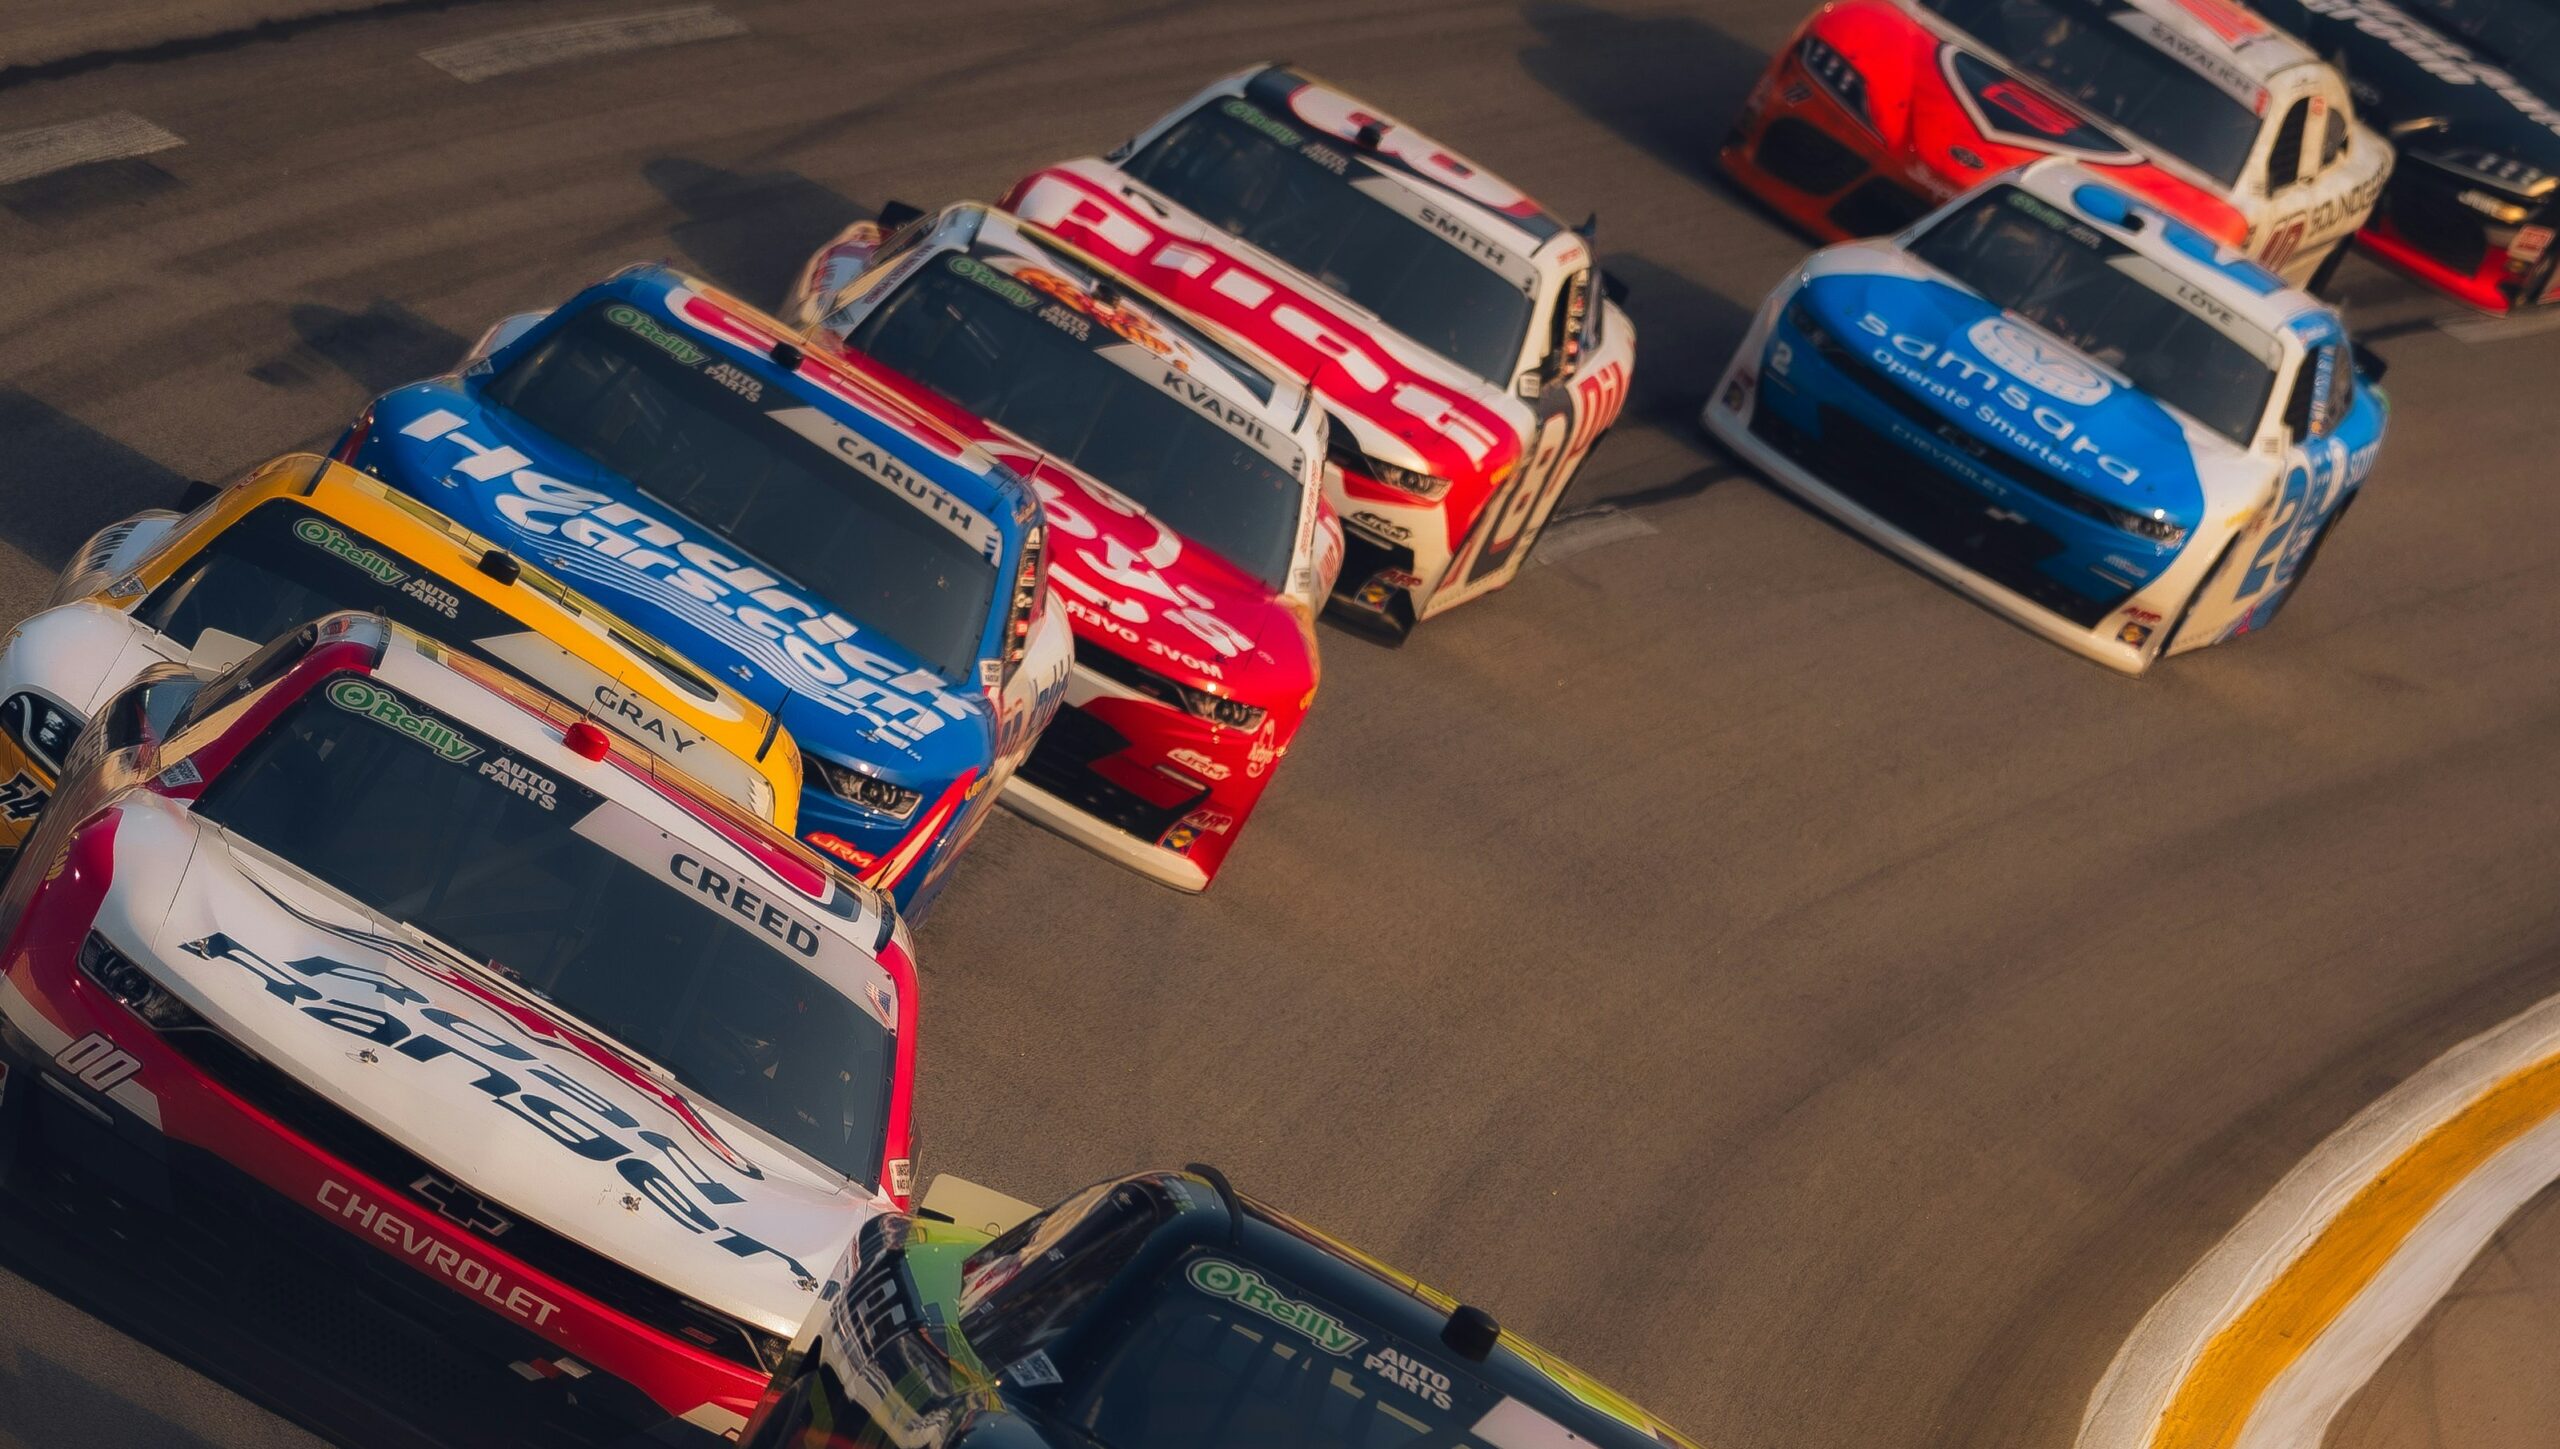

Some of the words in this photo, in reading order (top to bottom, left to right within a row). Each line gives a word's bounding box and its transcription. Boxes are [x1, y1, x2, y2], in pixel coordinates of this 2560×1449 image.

[1418, 206, 1506, 267] SMITH
[1037, 308, 1090, 342] PARTS
[1049, 305, 1091, 333] AUTO
[2177, 284, 2235, 326] LOVE
[603, 304, 711, 367] O'Reilly
[704, 366, 761, 404] PARTS
[714, 361, 764, 394] AUTO
[1856, 313, 2141, 486] samsara
[1162, 369, 1271, 451] KVAPIL
[1872, 348, 1972, 410] Operate
[1975, 403, 2074, 474] Smarter
[837, 436, 974, 532] CARUTH
[292, 516, 409, 587] O'Reilly
[399, 408, 982, 720] Hendrick
[401, 580, 458, 620] PARTS
[412, 576, 460, 609] AUTO
[325, 678, 486, 765] O'Reilly
[594, 684, 698, 755] GRAY
[479, 761, 558, 812] PARTS
[493, 756, 558, 797] AUTO
[811, 833, 874, 868] JRM
[668, 852, 822, 958] CREED
[56, 1032, 144, 1092] 00
[316, 1178, 562, 1327] CHEVROLET
[1185, 1256, 1370, 1358] O'Reilly
[1363, 1353, 1453, 1412] PARTS
[1377, 1346, 1452, 1393] AUTO
